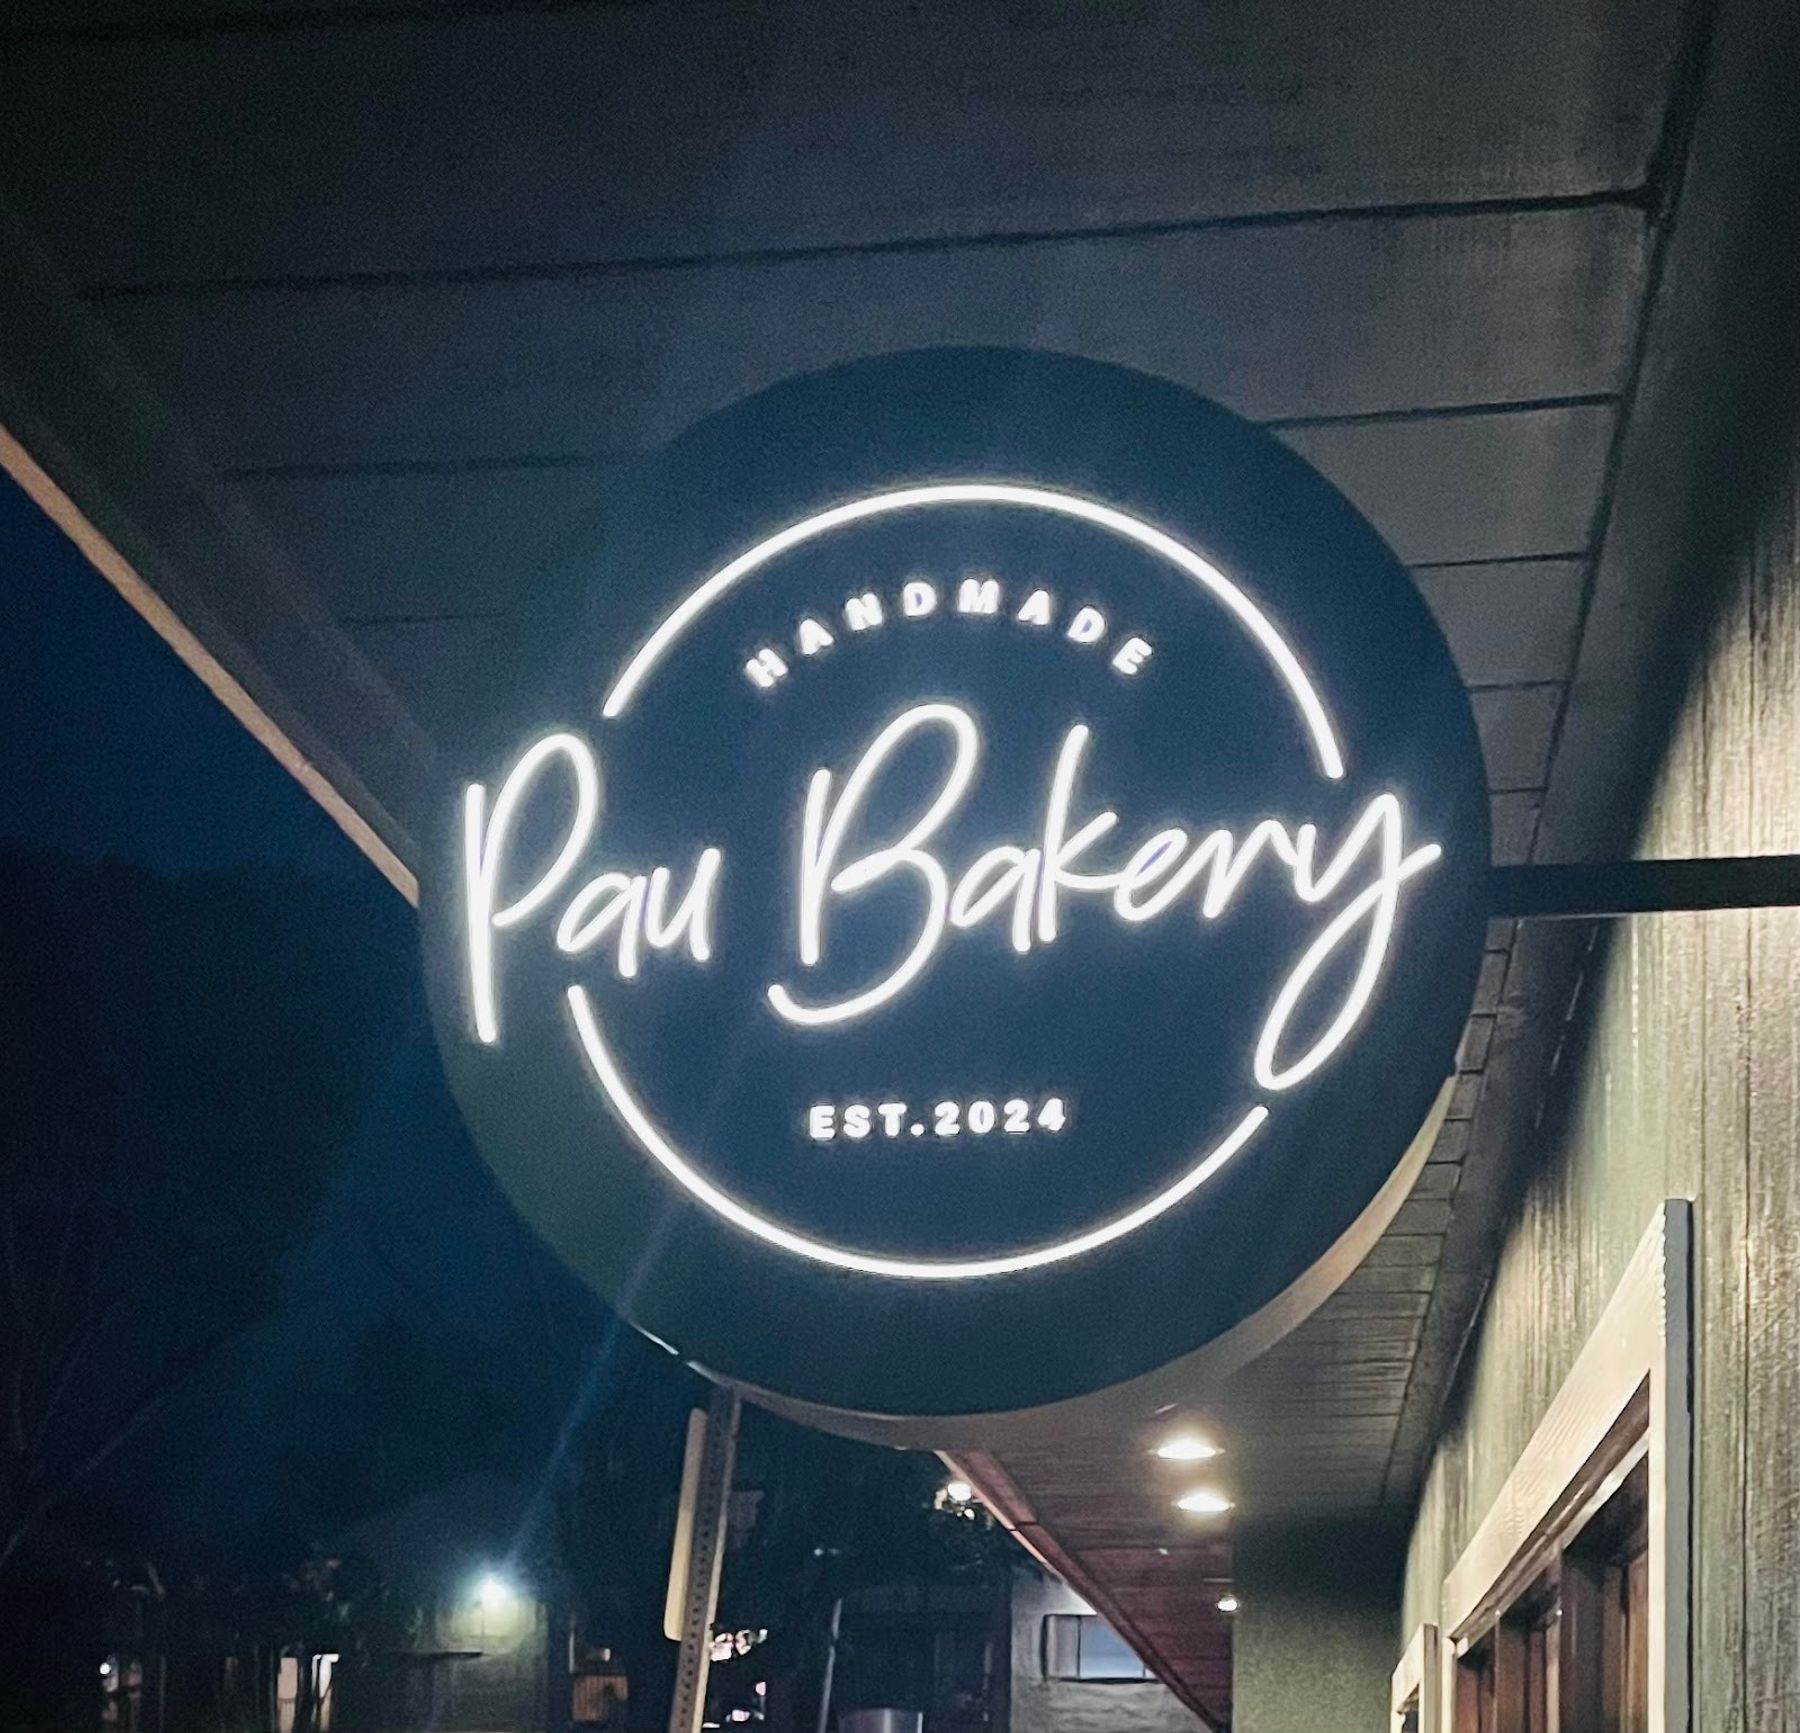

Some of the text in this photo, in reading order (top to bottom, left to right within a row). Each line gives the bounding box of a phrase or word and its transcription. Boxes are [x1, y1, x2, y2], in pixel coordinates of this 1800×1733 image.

[745, 578, 1153, 688] HANDMADE
[463, 702, 1443, 1092] Pau Bakery
[808, 1097, 1067, 1139] EST.2024
